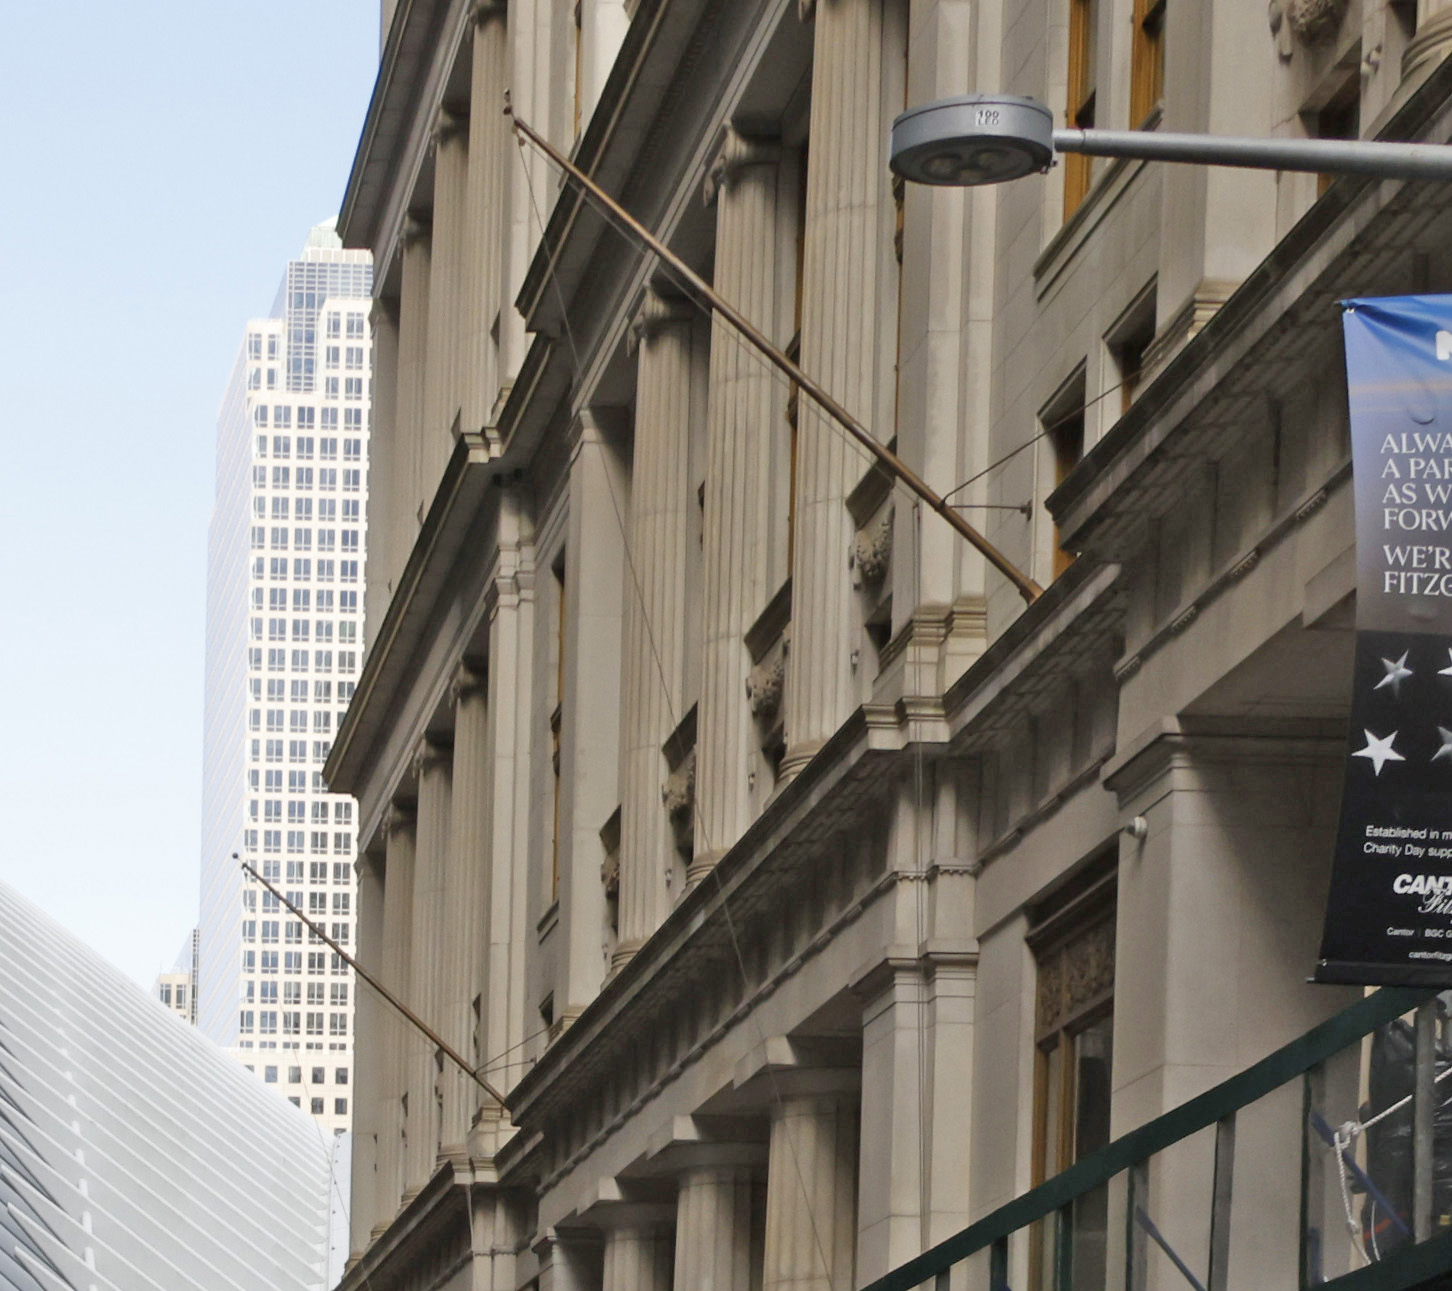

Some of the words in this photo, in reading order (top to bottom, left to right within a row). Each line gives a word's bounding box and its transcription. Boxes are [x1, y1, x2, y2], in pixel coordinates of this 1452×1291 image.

[1381, 458, 1401, 479] A
[1382, 483, 1417, 505] AS
[1365, 825, 1427, 840] Established
[1429, 828, 1439, 840] in
[1363, 842, 1401, 857] Charity
[1405, 844, 1425, 858] Day
[1387, 927, 1415, 937] Cantor
[1424, 928, 1444, 939] BGC
